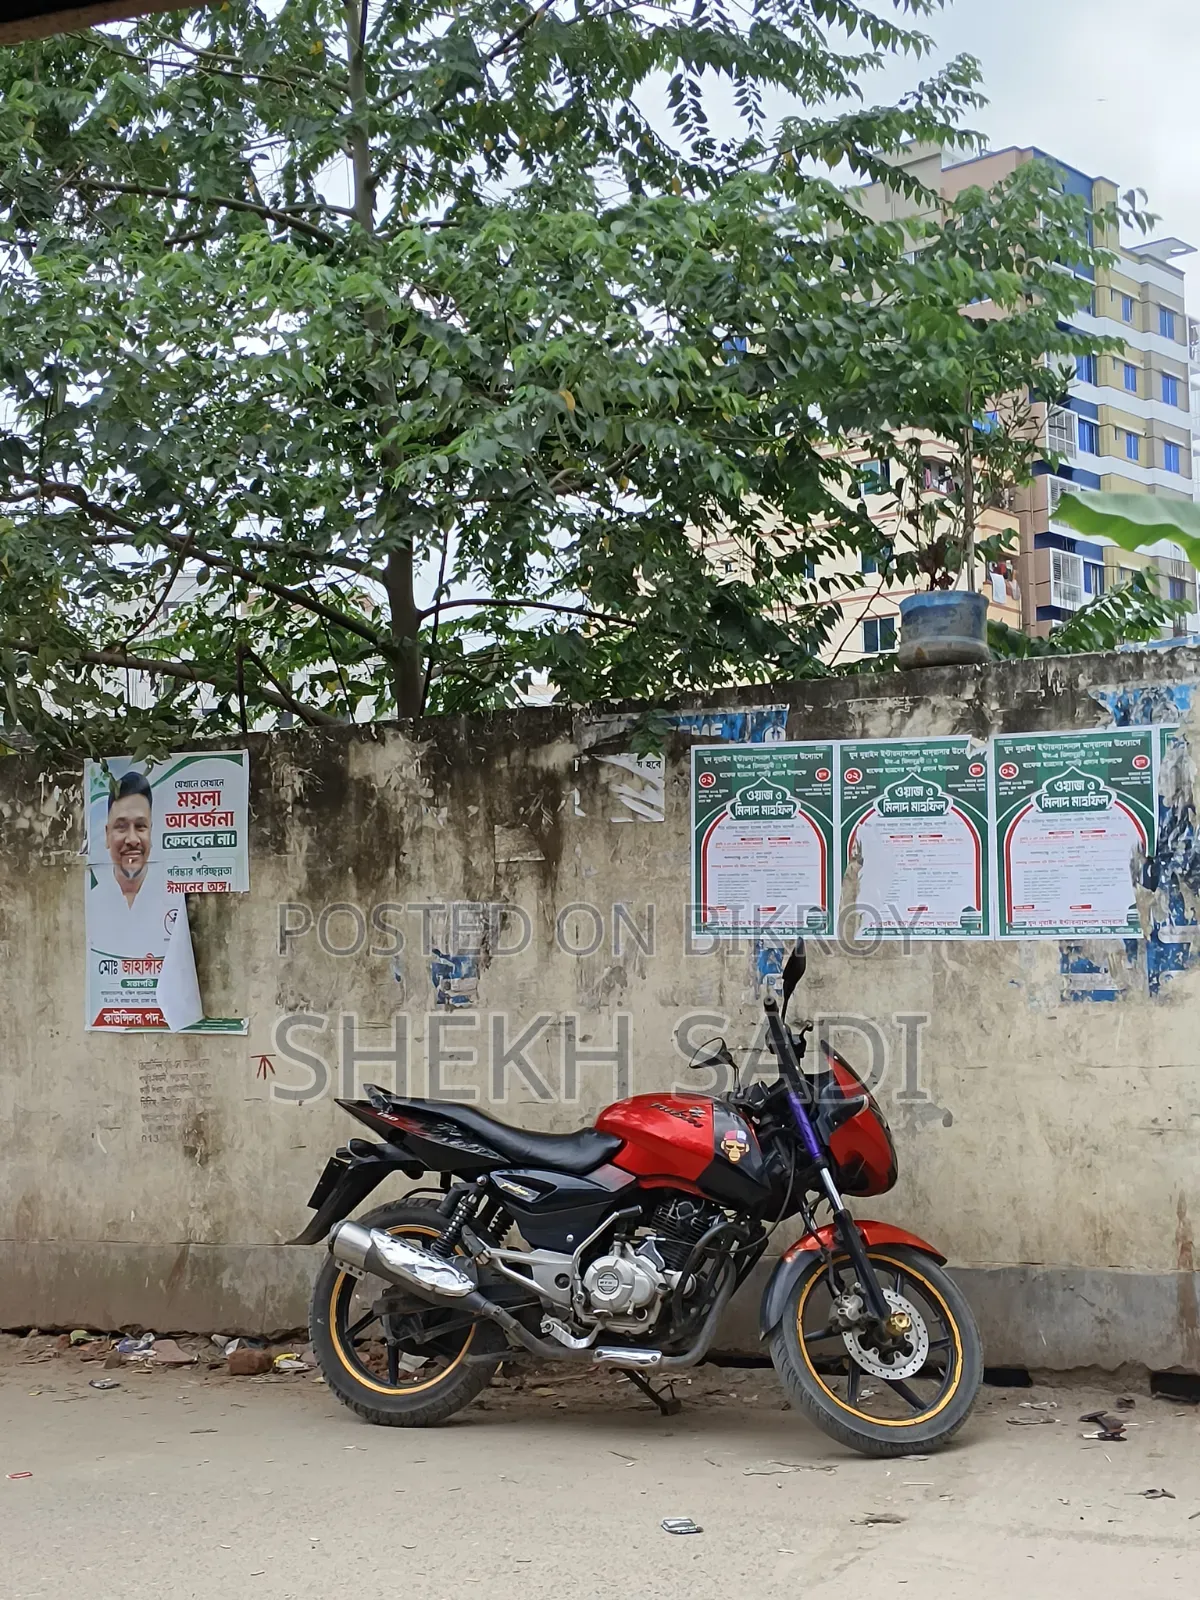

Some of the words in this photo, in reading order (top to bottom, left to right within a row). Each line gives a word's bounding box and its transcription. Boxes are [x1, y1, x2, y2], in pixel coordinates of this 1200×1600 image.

[846, 772, 858, 780] ০২
[1002, 766, 1015, 775] ০২
[174, 780, 199, 788] যেখানে
[200, 779, 224, 788] সেখানে
[702, 776, 712, 784] ০২
[1054, 780, 1085, 792] ওয়াজ
[746, 790, 772, 801] ওয়াজ
[775, 792, 782, 800] ও
[895, 786, 923, 798] ওয়াজ
[926, 788, 934, 796] ও
[177, 790, 222, 810] ময়লা
[883, 799, 909, 813] মিলাদ
[911, 798, 946, 812] মাহফিল
[1042, 794, 1070, 808] মিলাদ
[1072, 793, 1108, 808] মাহফিল
[735, 803, 759, 816] মিলাদ
[762, 802, 794, 816] মাহফিল
[165, 808, 234, 828] আবর্জনা
[164, 834, 214, 848] ফেলবেন
[98, 959, 118, 975] মোঃ
[121, 953, 164, 976] জাহাঙ্গীর
[126, 980, 154, 988] সভাপতি
